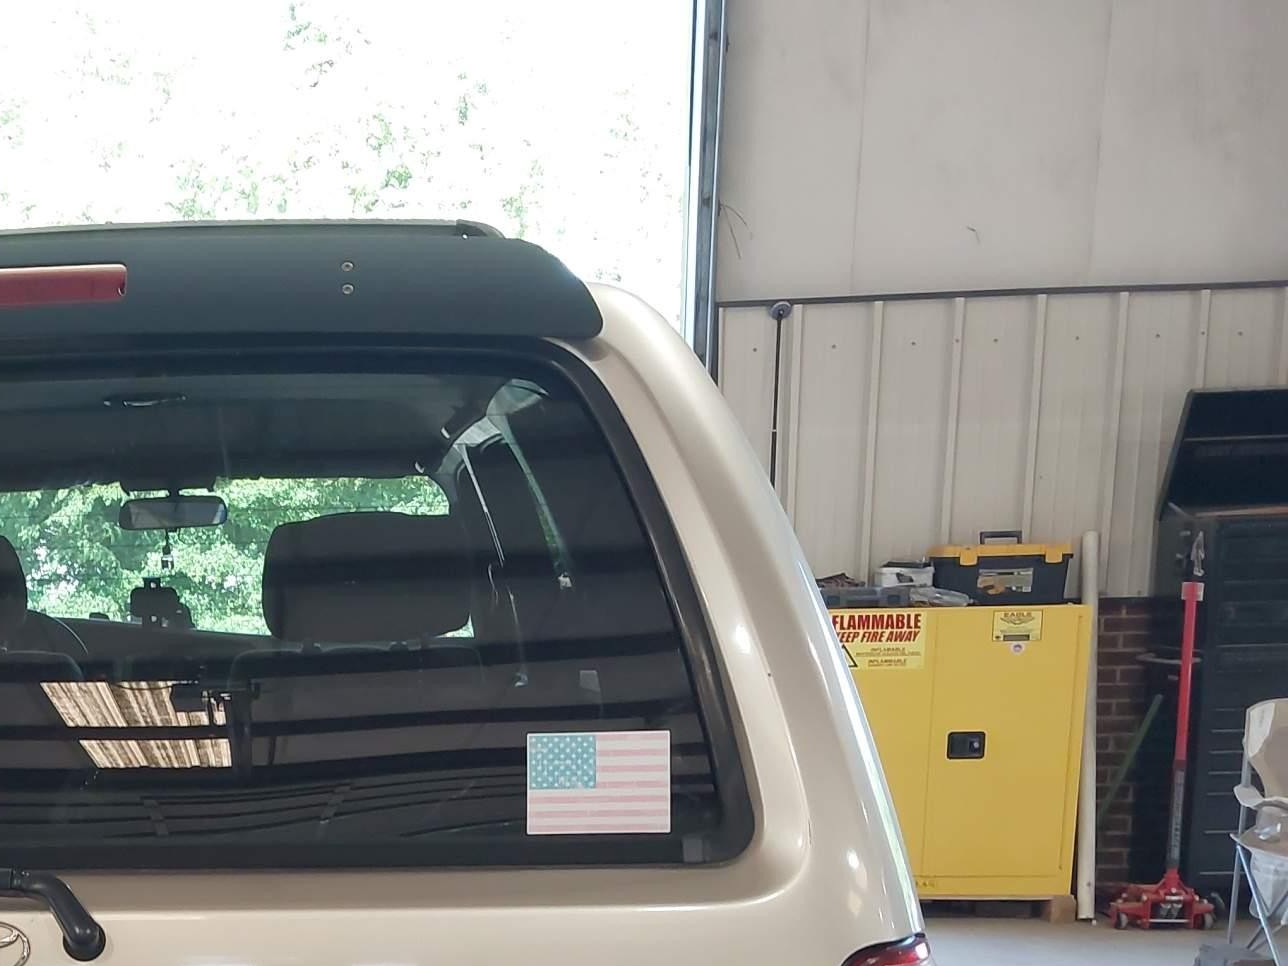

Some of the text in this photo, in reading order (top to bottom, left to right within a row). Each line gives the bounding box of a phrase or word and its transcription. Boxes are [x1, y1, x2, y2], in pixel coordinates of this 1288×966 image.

[832, 613, 922, 631] FLAMMABLE
[860, 631, 885, 643] FIRE
[885, 630, 920, 643] AWAY
